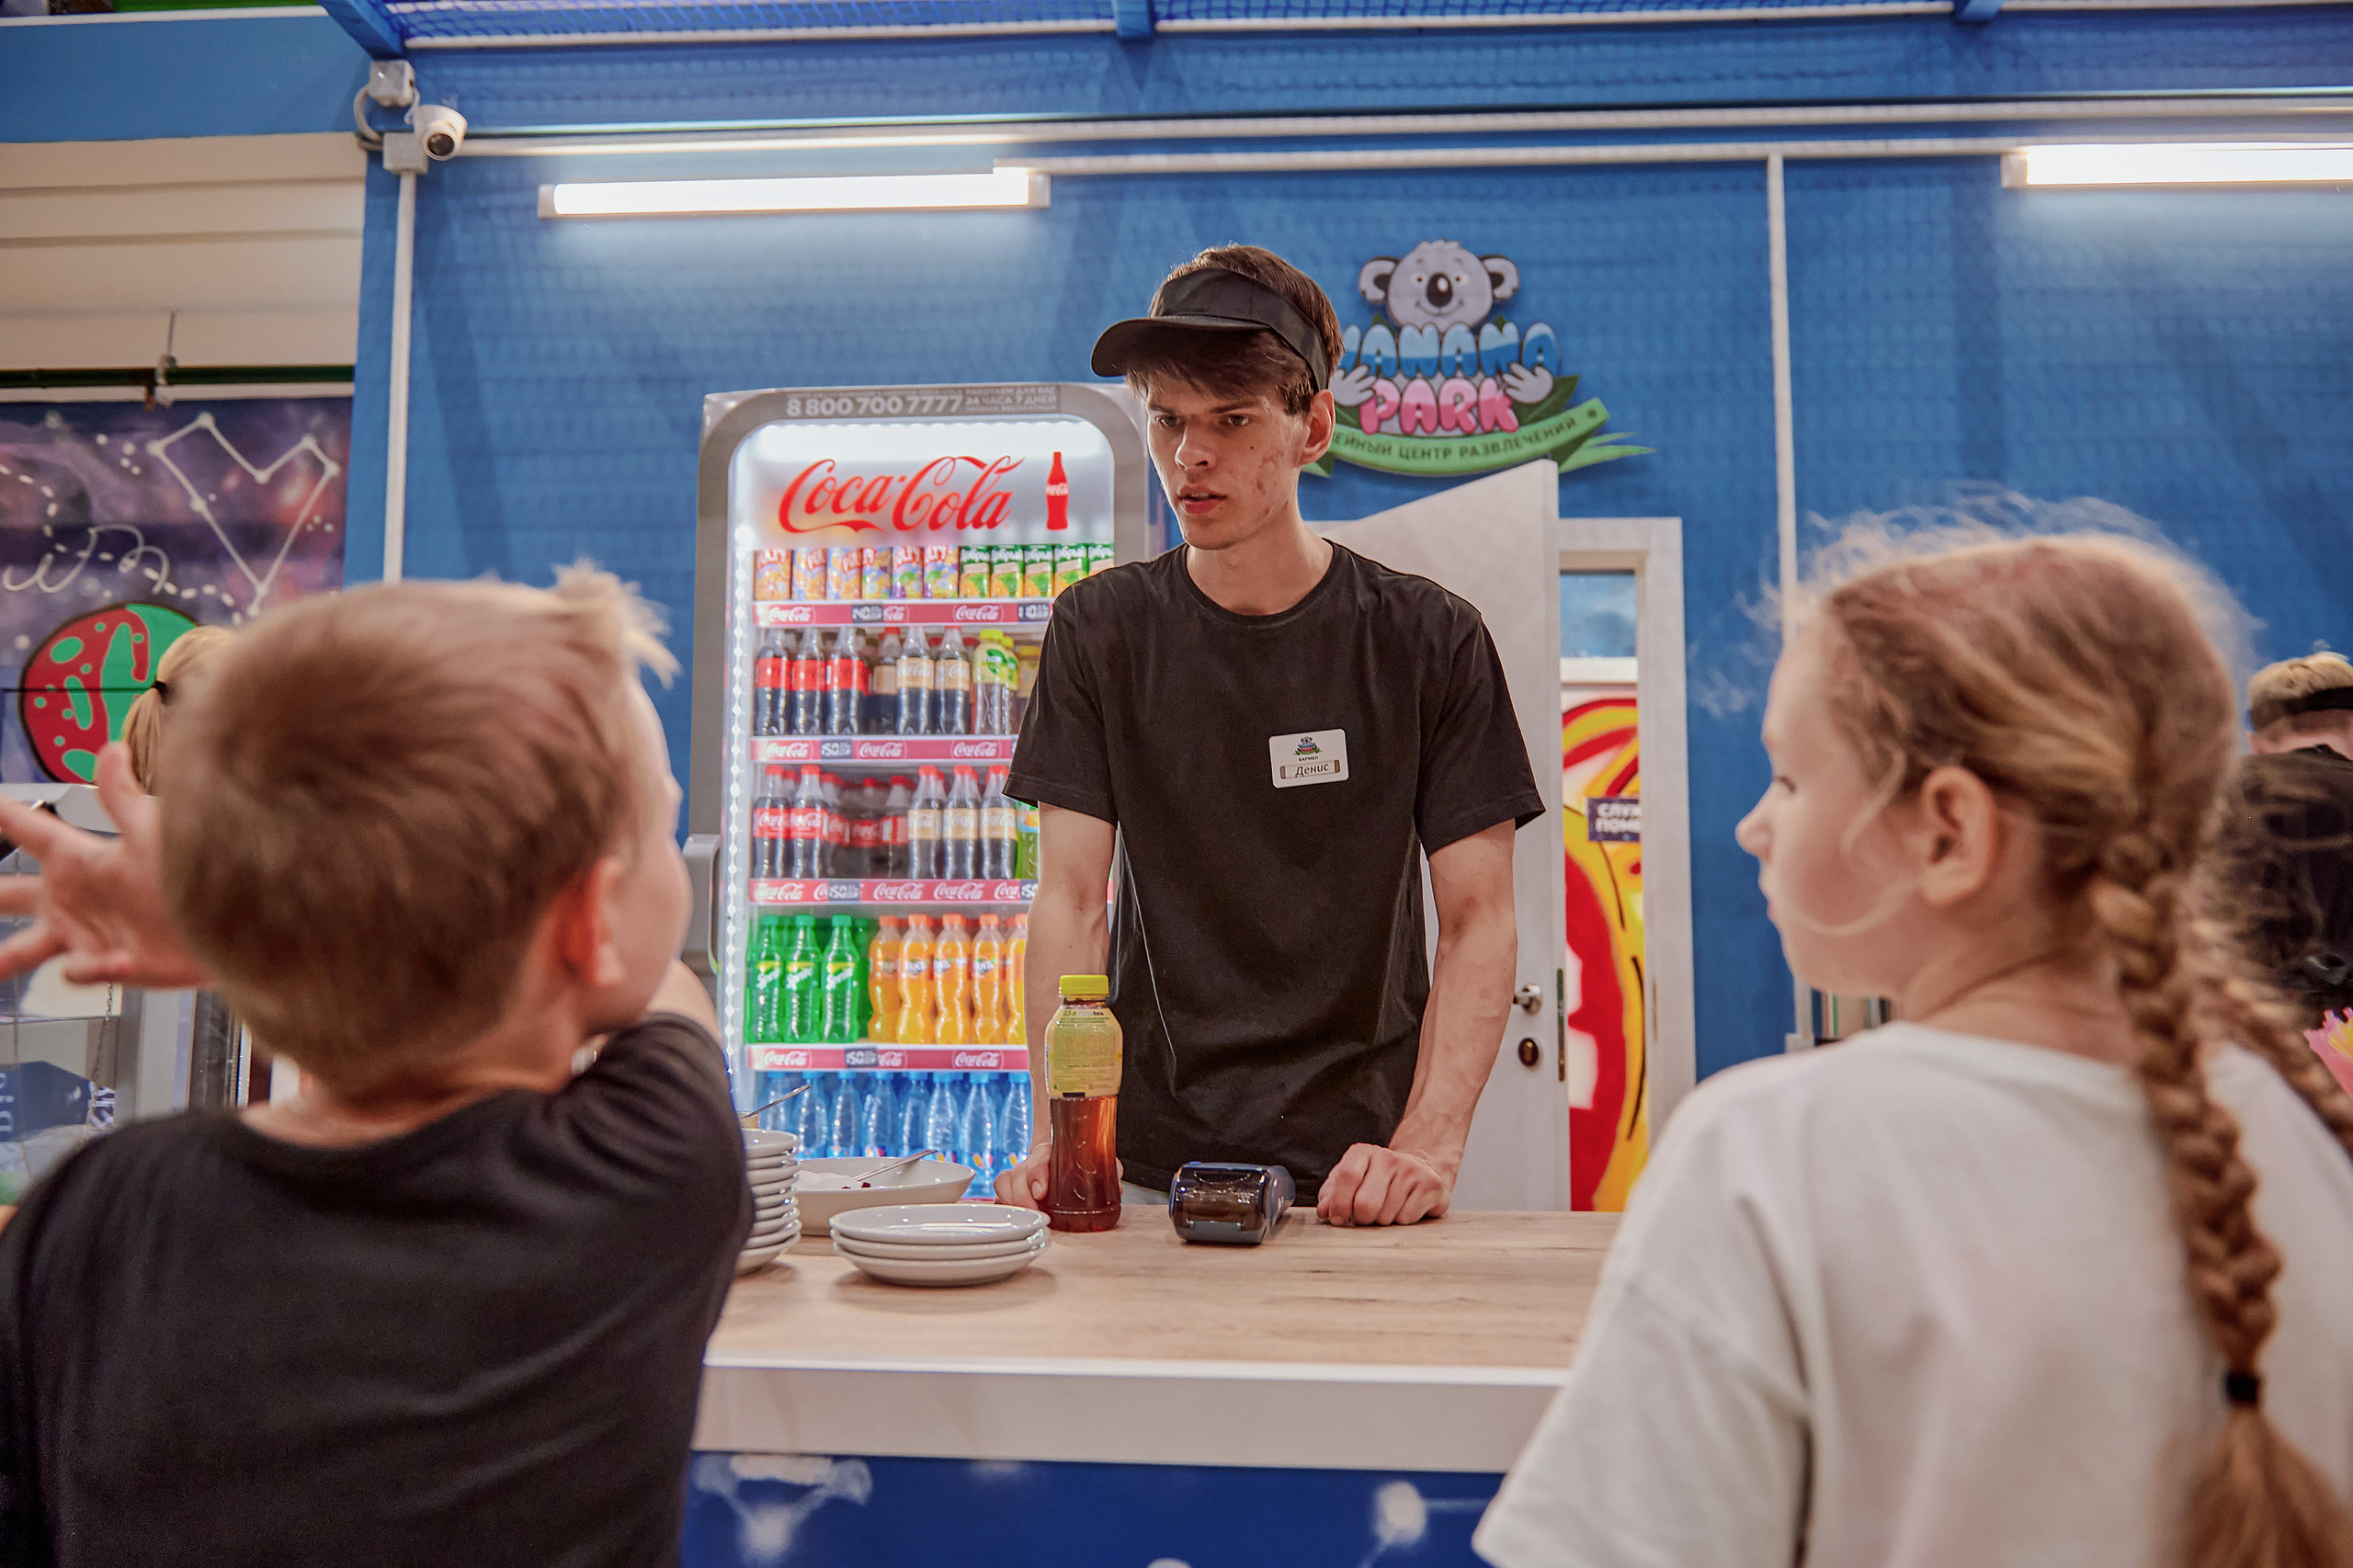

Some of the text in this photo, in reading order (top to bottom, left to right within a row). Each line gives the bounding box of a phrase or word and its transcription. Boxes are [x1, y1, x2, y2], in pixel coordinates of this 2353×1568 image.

[787, 394, 963, 416] 8 800 700 7777
[1359, 378, 1520, 435] PARK
[1334, 416, 1578, 460] ЕЙНЫЙ ЦЕНТР РАЗВЛЕЧЕНИЙ
[1295, 764, 1329, 778] Денис
